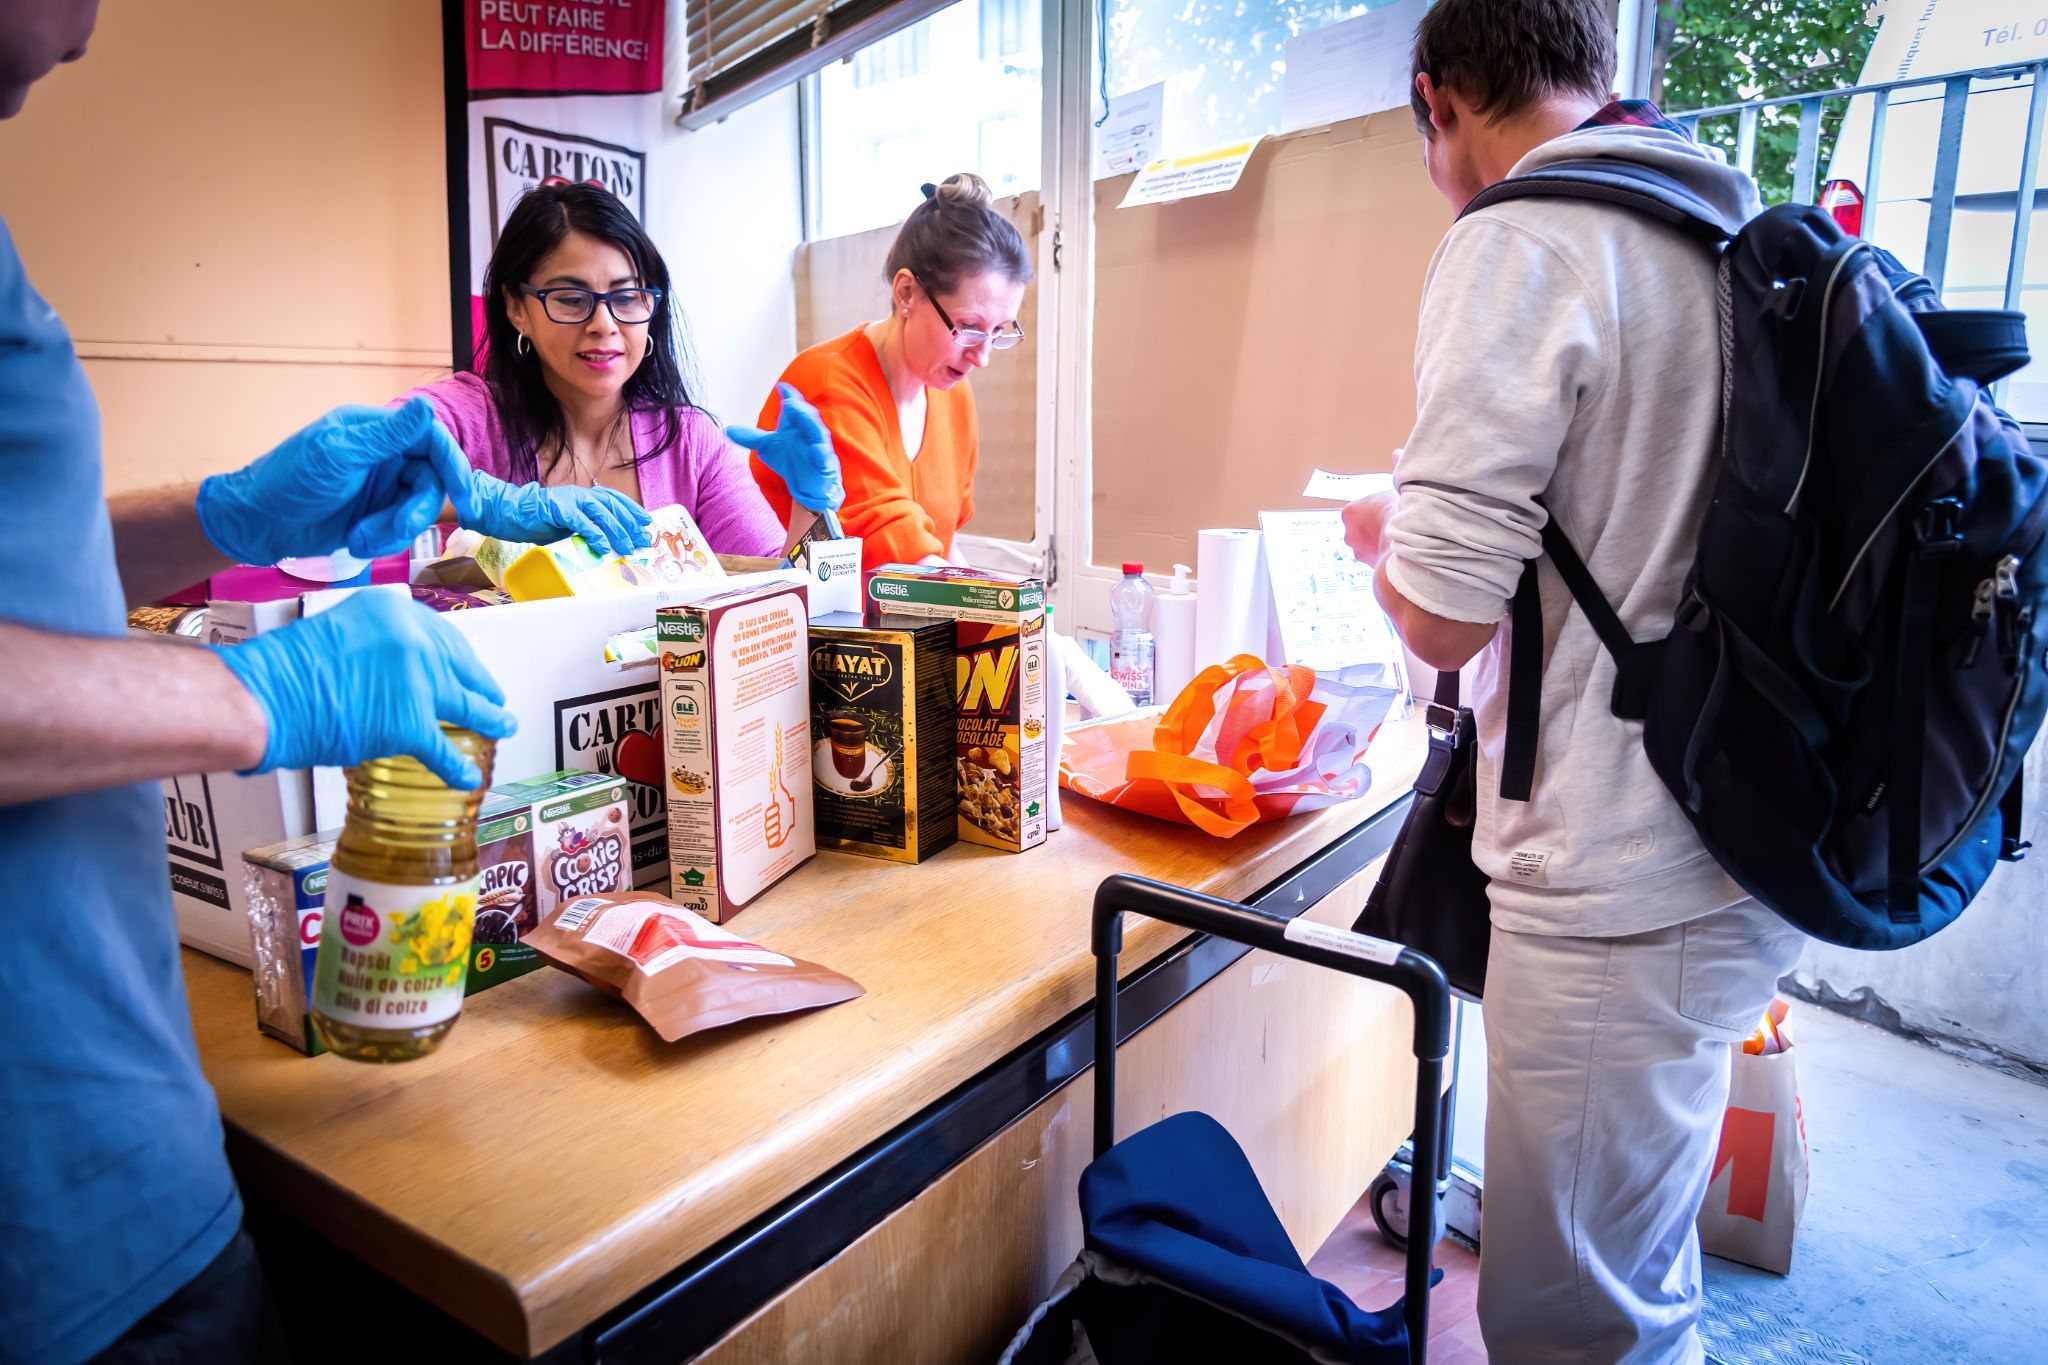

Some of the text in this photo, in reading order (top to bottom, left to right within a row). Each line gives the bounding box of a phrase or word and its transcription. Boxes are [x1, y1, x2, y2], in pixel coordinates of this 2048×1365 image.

[480, 1, 605, 31] PEUT FAIRE
[481, 28, 515, 50] LA
[1983, 23, 2022, 46] Tél.
[503, 137, 634, 198] CARTONS
[674, 652, 702, 668] LION
[816, 652, 886, 676] HAYAT
[1113, 671, 1142, 681] SWISS
[1122, 681, 1143, 690] PINA
[676, 702, 694, 712] BLÉ
[569, 698, 659, 752] CART
[957, 718, 999, 732] OCOLAT
[957, 731, 1005, 747] OCOLADE
[170, 873, 225, 900] -coeur.swiss
[479, 864, 526, 895] APIC
[478, 950, 492, 969] 5
[378, 977, 398, 993] de
[403, 976, 443, 994] colza
[366, 997, 380, 1014] di
[386, 999, 428, 1015] colza
